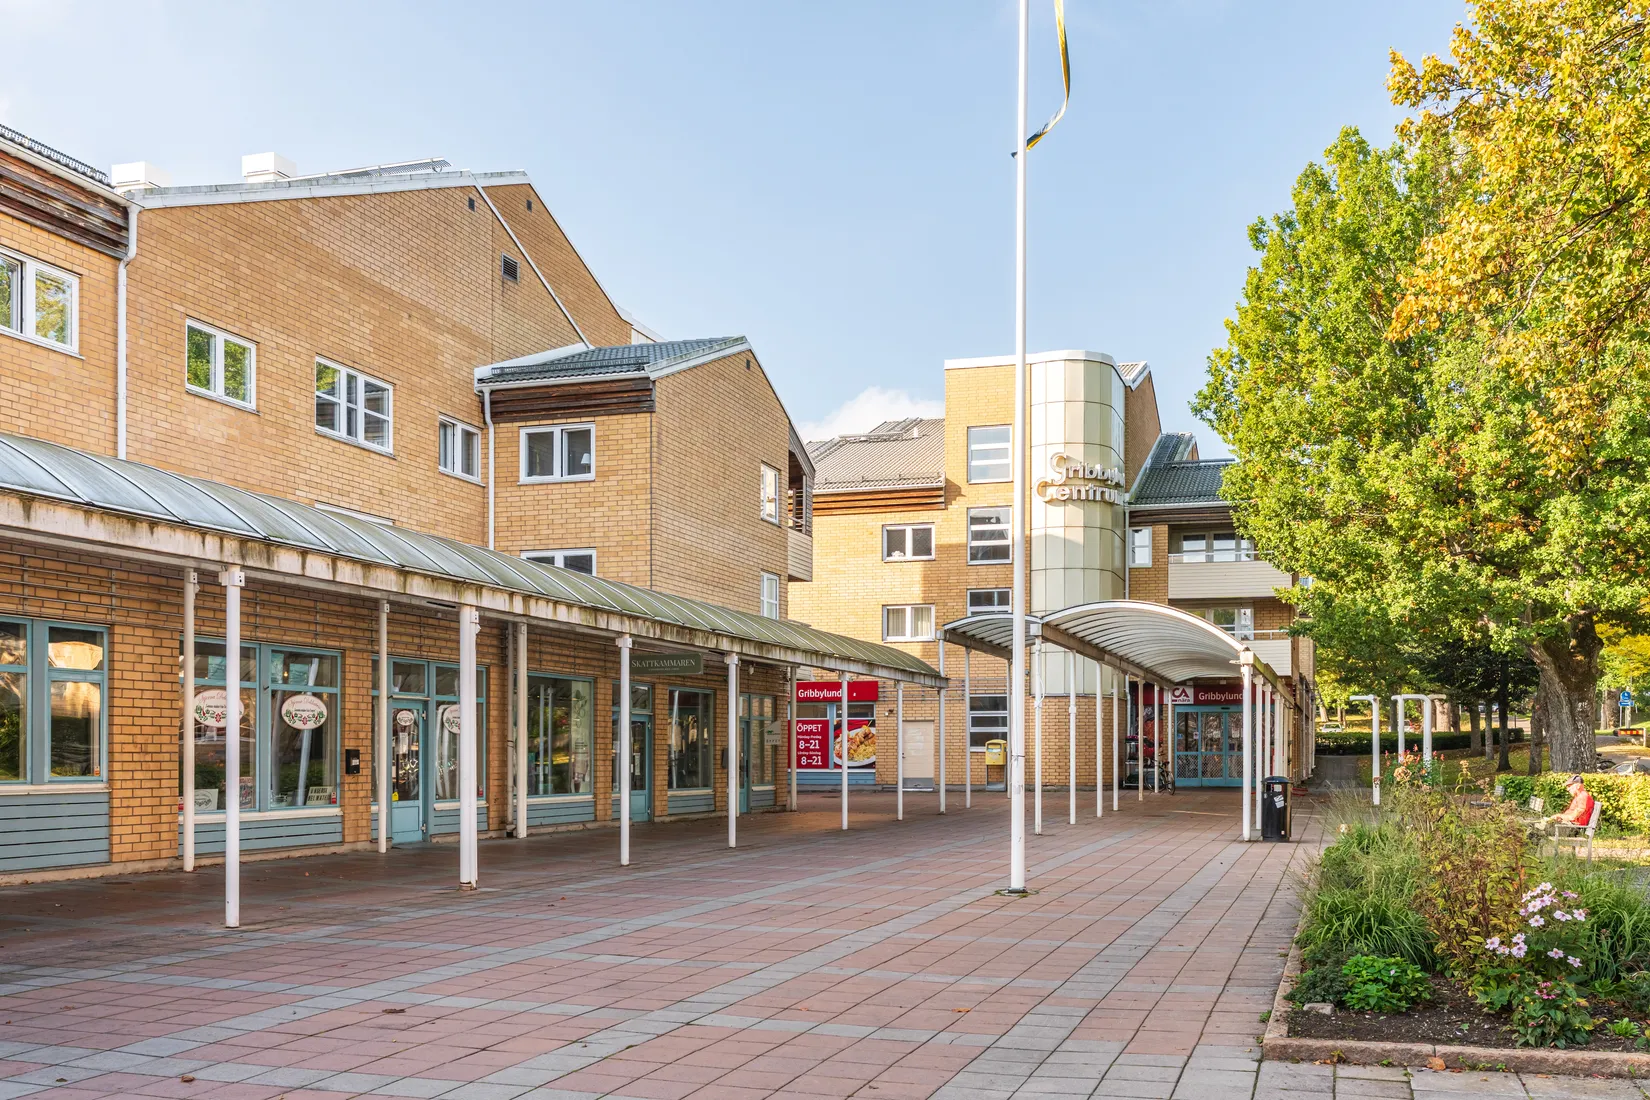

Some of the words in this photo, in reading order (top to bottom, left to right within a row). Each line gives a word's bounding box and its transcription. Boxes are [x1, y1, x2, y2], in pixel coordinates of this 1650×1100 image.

[631, 659, 695, 667] SKATTKAMMAREN
[798, 689, 842, 698] Gribbylund
[1172, 687, 1190, 698] CA
[797, 722, 822, 732] ÖPPET
